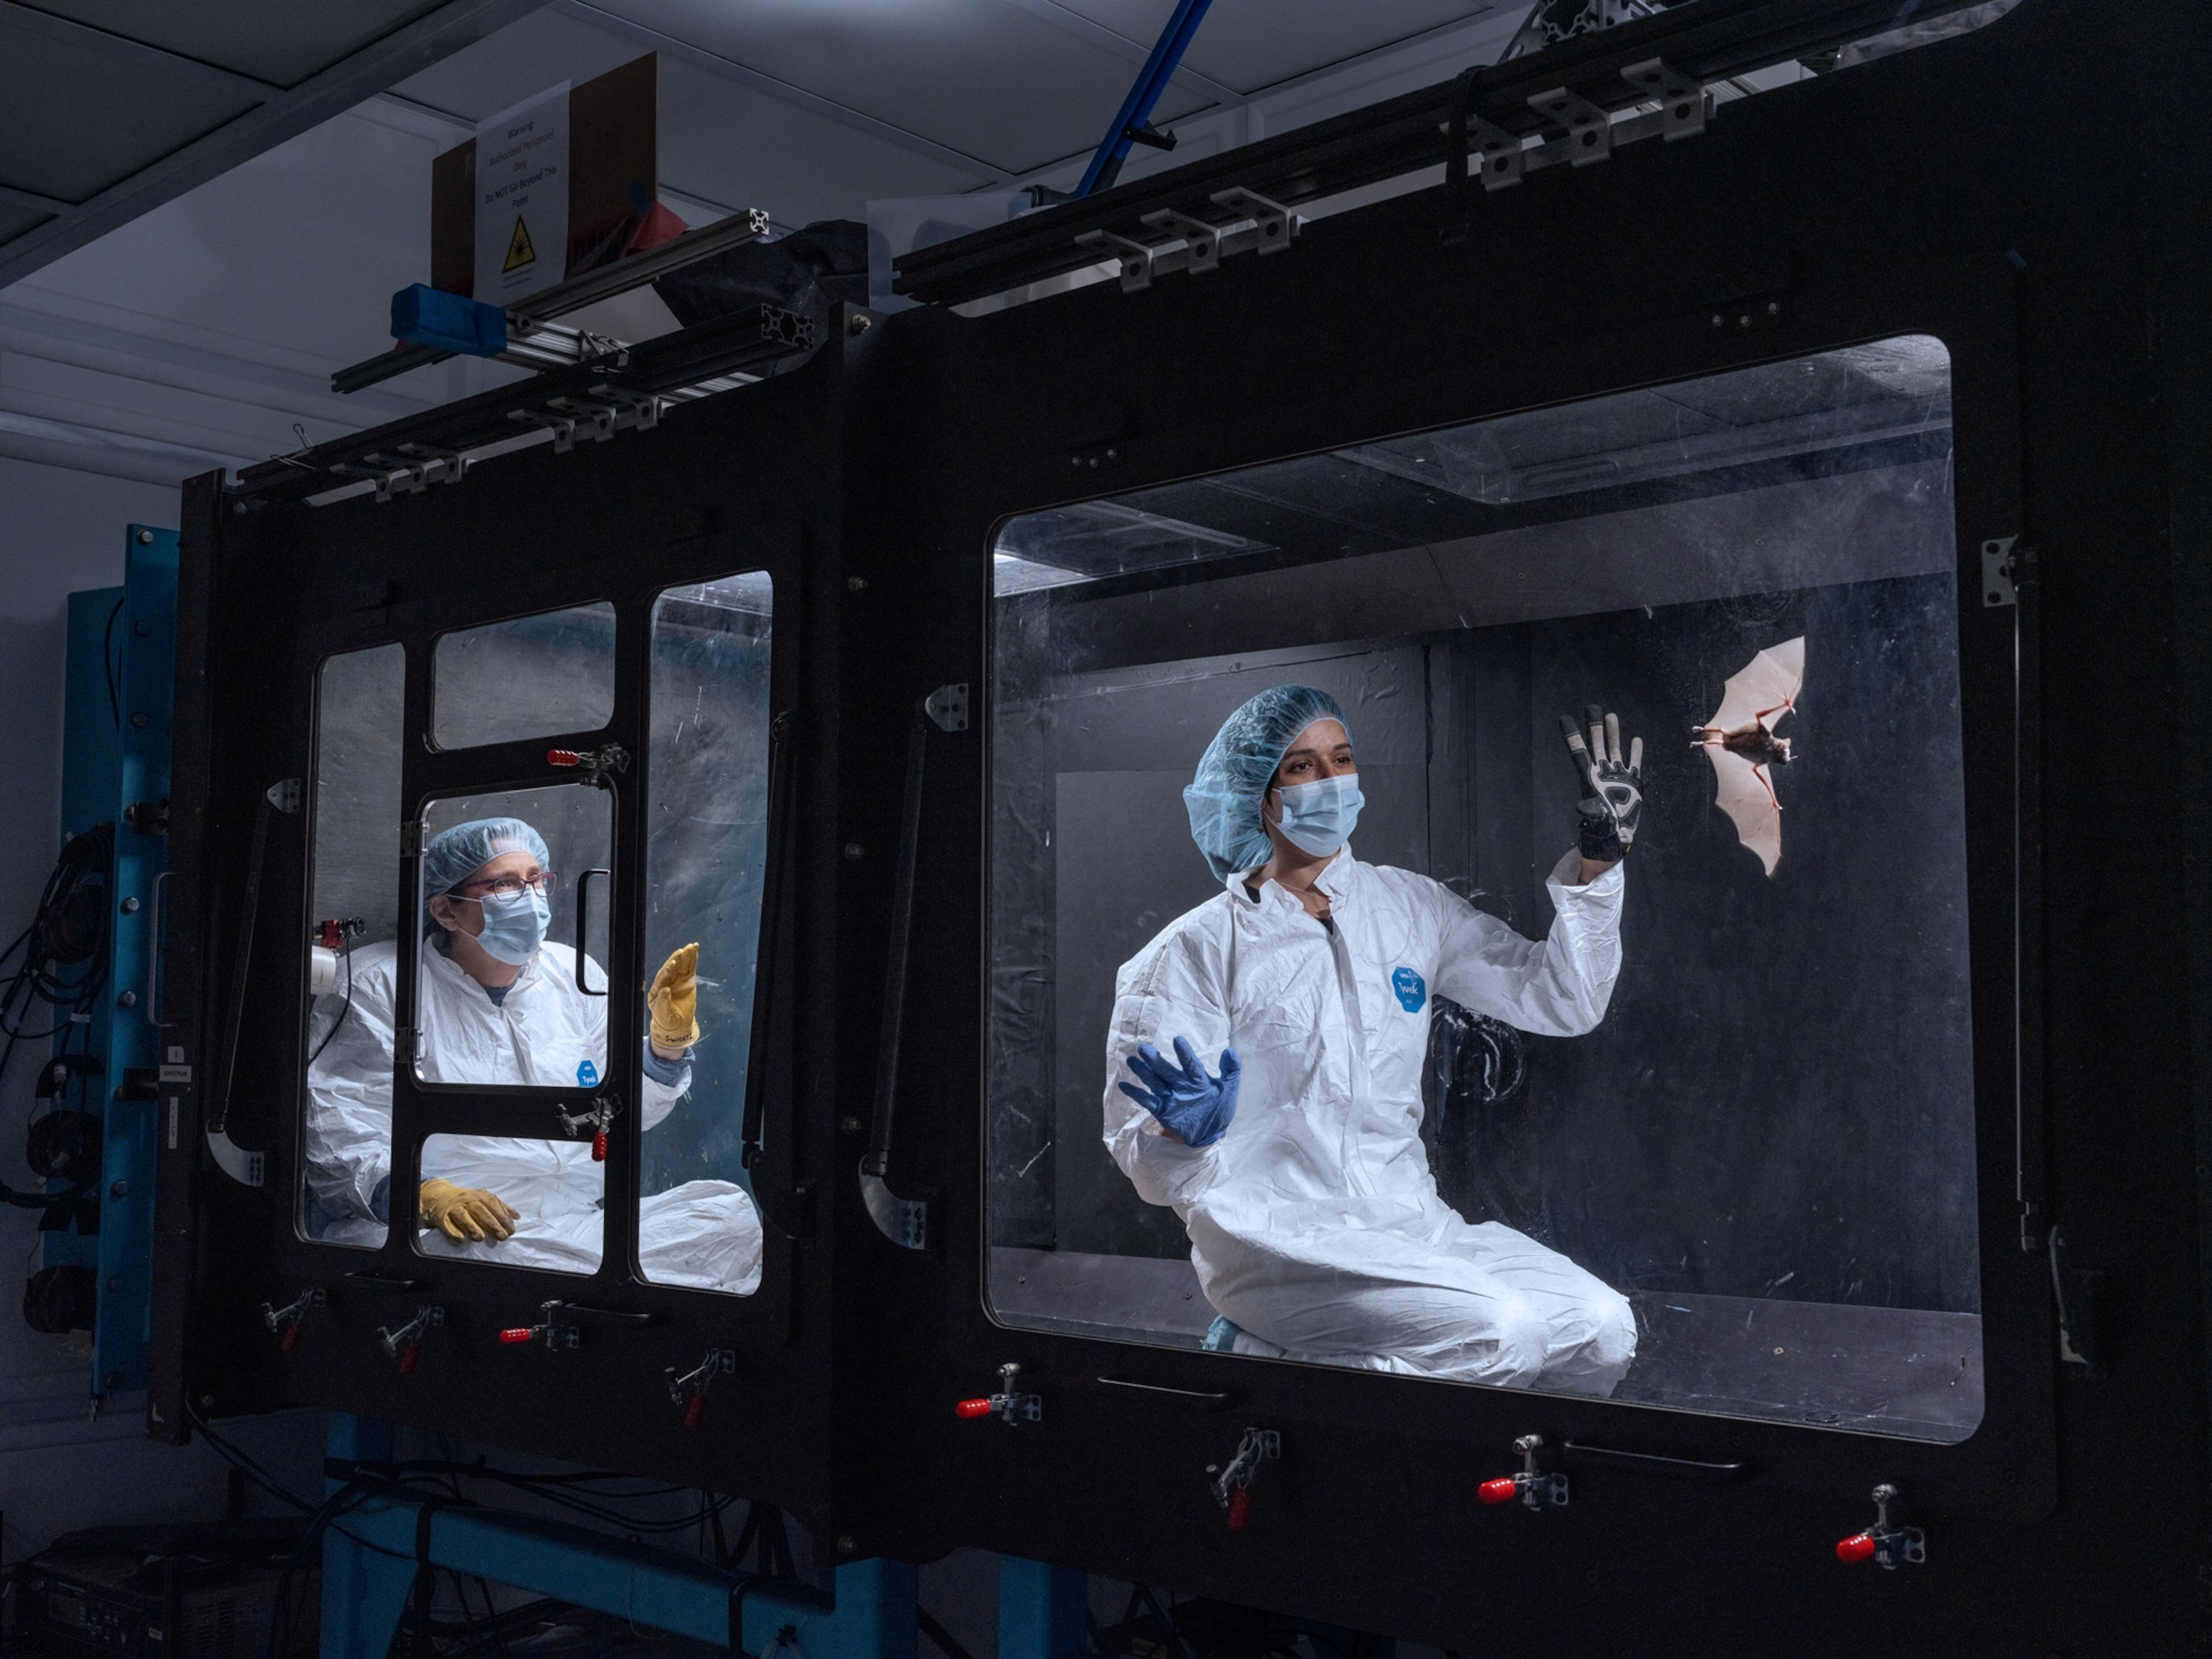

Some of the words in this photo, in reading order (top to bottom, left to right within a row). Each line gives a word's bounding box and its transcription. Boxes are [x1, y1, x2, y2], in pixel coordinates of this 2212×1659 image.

[507, 121, 535, 140] Warning:
[489, 143, 522, 167] Authorized
[523, 128, 554, 150] Personnel
[513, 159, 528, 172] Only
[485, 194, 495, 204] Do
[495, 185, 508, 199] NOT
[509, 183, 518, 193] Go
[519, 169, 543, 189] Beyond
[544, 165, 557, 178] This
[512, 195, 529, 209] Point
[1397, 981, 1418, 994] Tyvek
[582, 1075, 596, 1084] Tyvek
